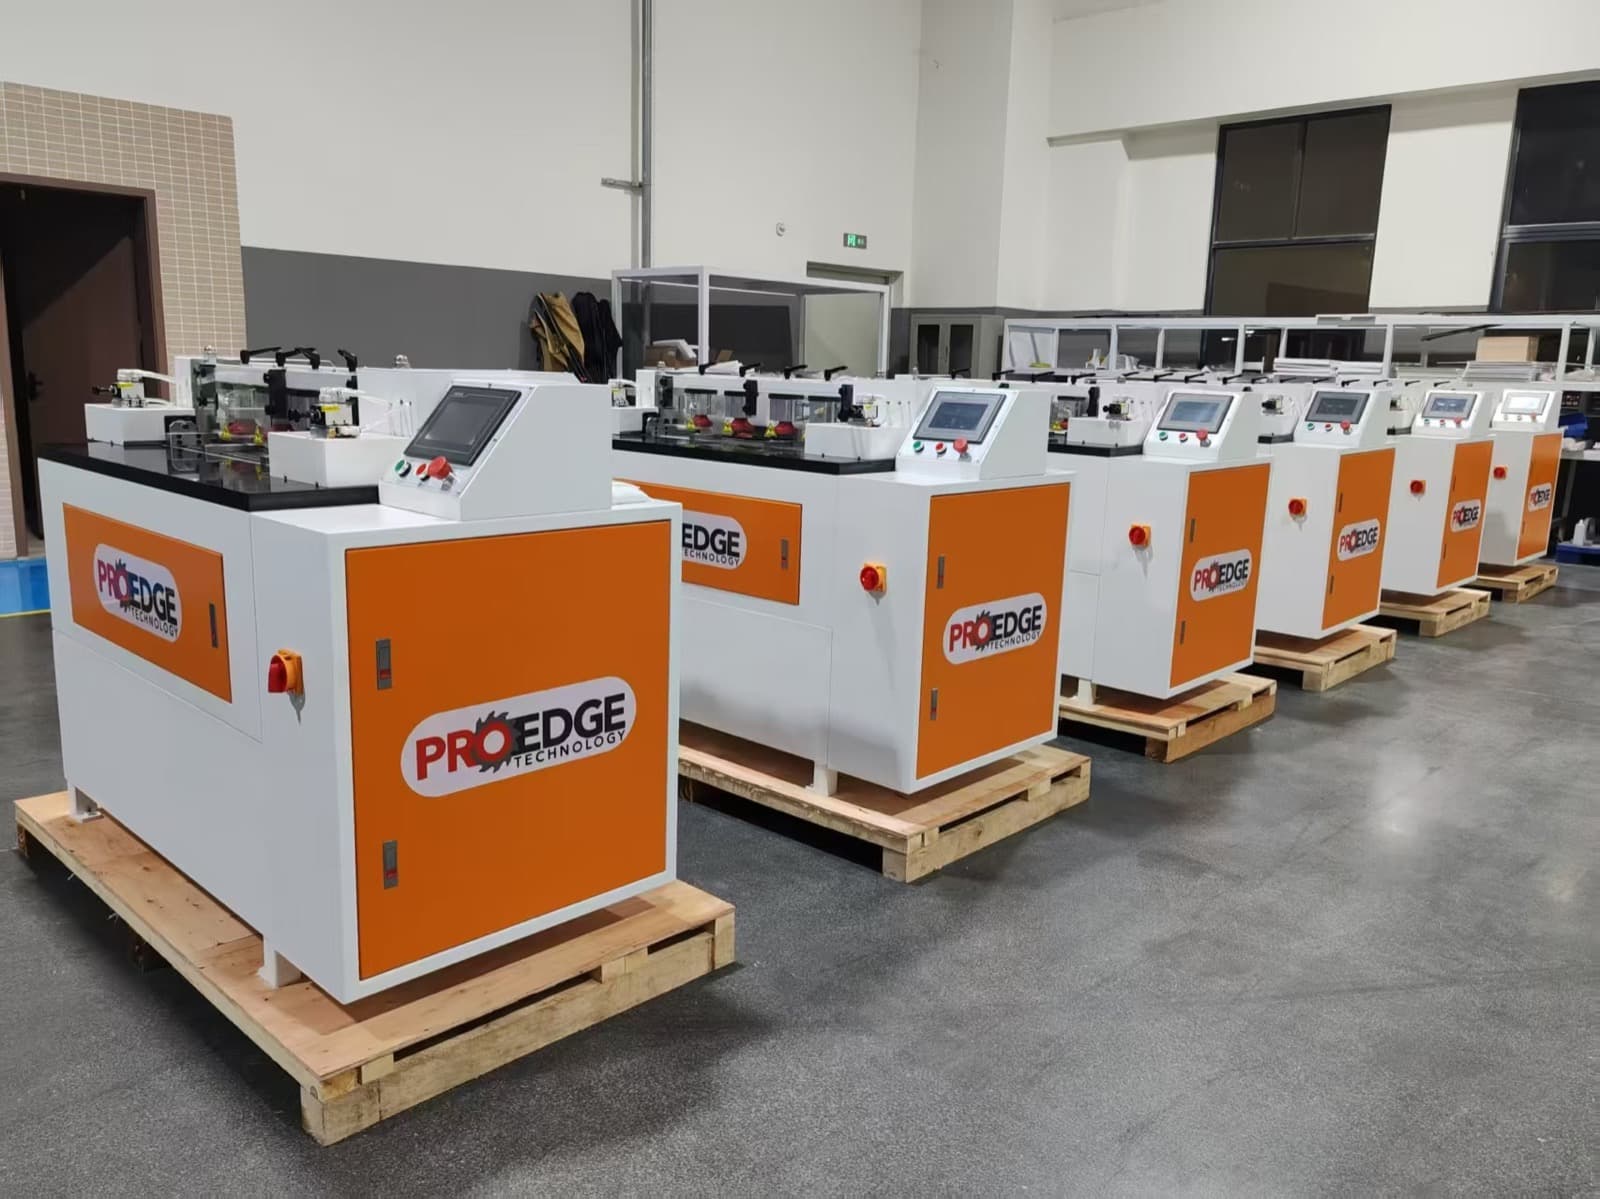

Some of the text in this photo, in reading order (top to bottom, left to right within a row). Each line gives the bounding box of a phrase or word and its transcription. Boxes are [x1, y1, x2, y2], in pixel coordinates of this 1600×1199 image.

[682, 523, 740, 557] EDGE
[684, 548, 740, 566] ECHNOLOGY
[98, 559, 178, 625] PROEDGE
[1194, 558, 1249, 592] PROEDGE
[131, 607, 178, 636] TECHNOLOGY
[949, 604, 1042, 652] PROEDGE
[990, 631, 1041, 650] TECHNOLOGY
[416, 693, 626, 780] PROEDGE
[514, 730, 626, 768] TECHNOLOGY
